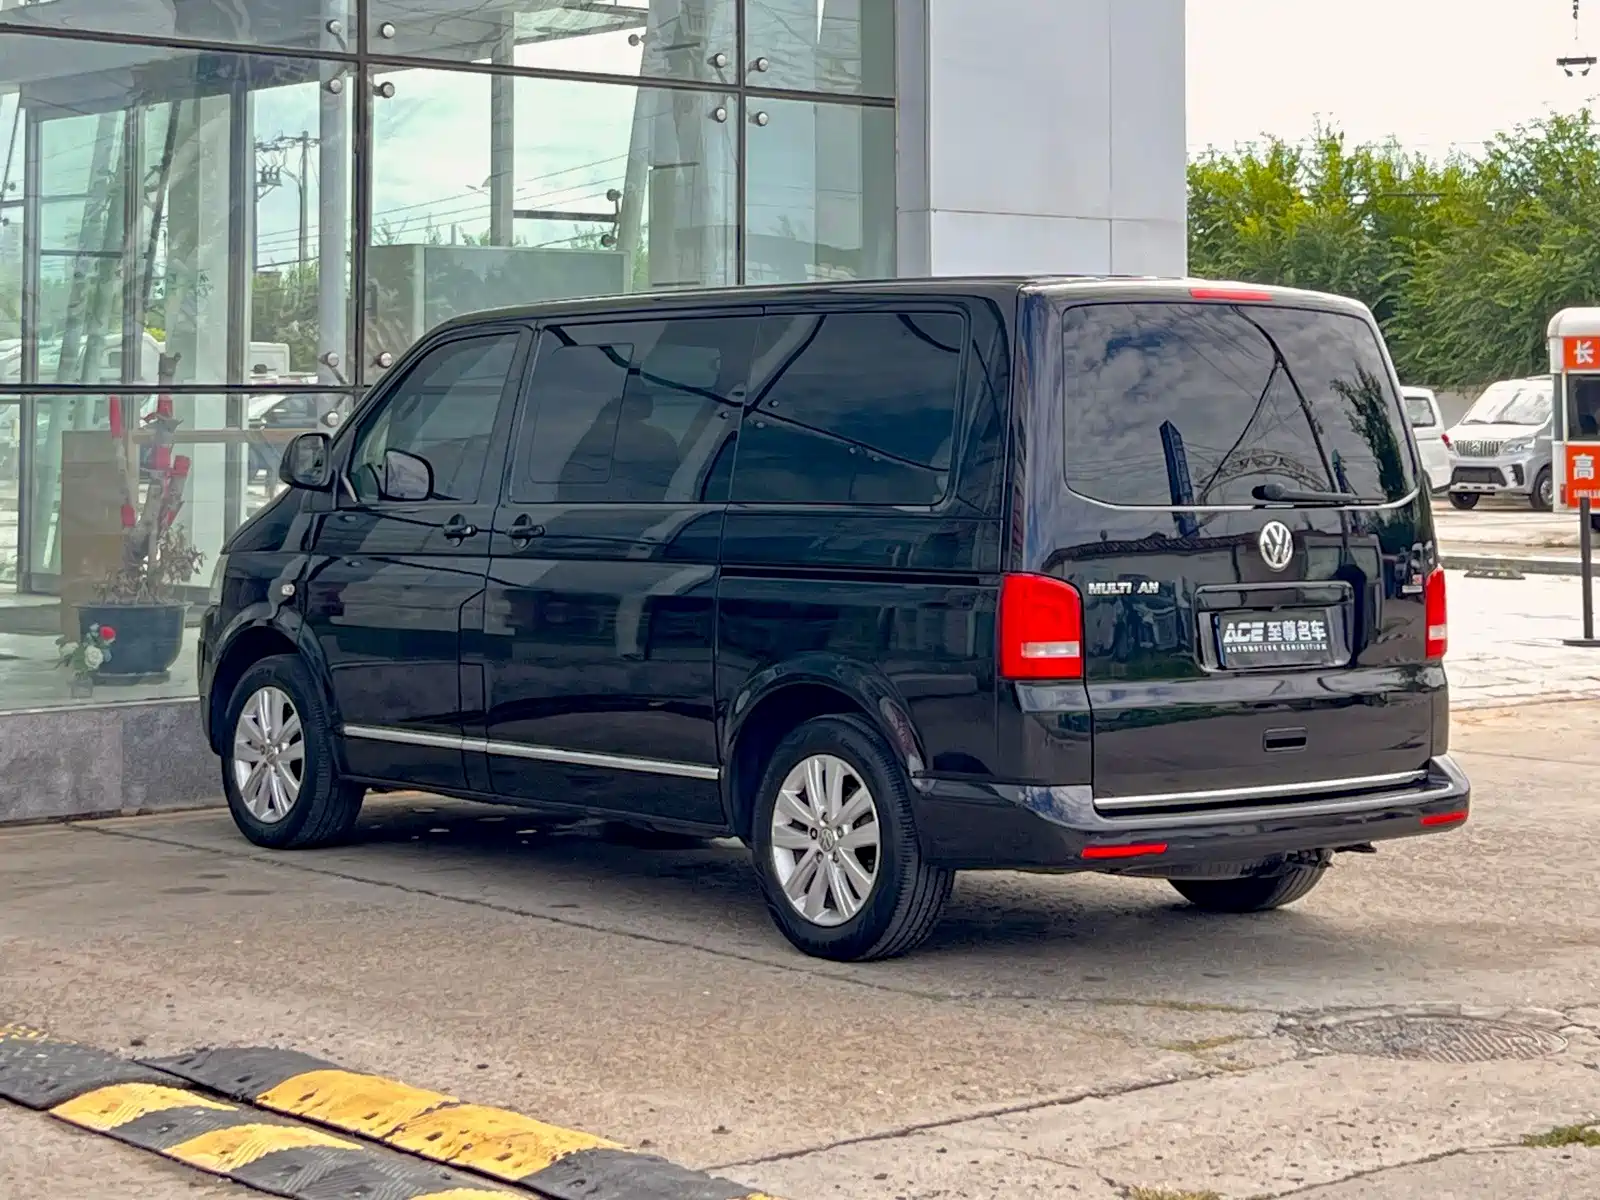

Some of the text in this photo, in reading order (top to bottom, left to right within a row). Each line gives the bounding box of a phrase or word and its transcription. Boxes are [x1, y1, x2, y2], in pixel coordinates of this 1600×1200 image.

[1573, 340, 1594, 364] 长
[1572, 453, 1594, 480] 高
[1223, 622, 1264, 642] ACE
[1267, 620, 1326, 641] 至尊名车
